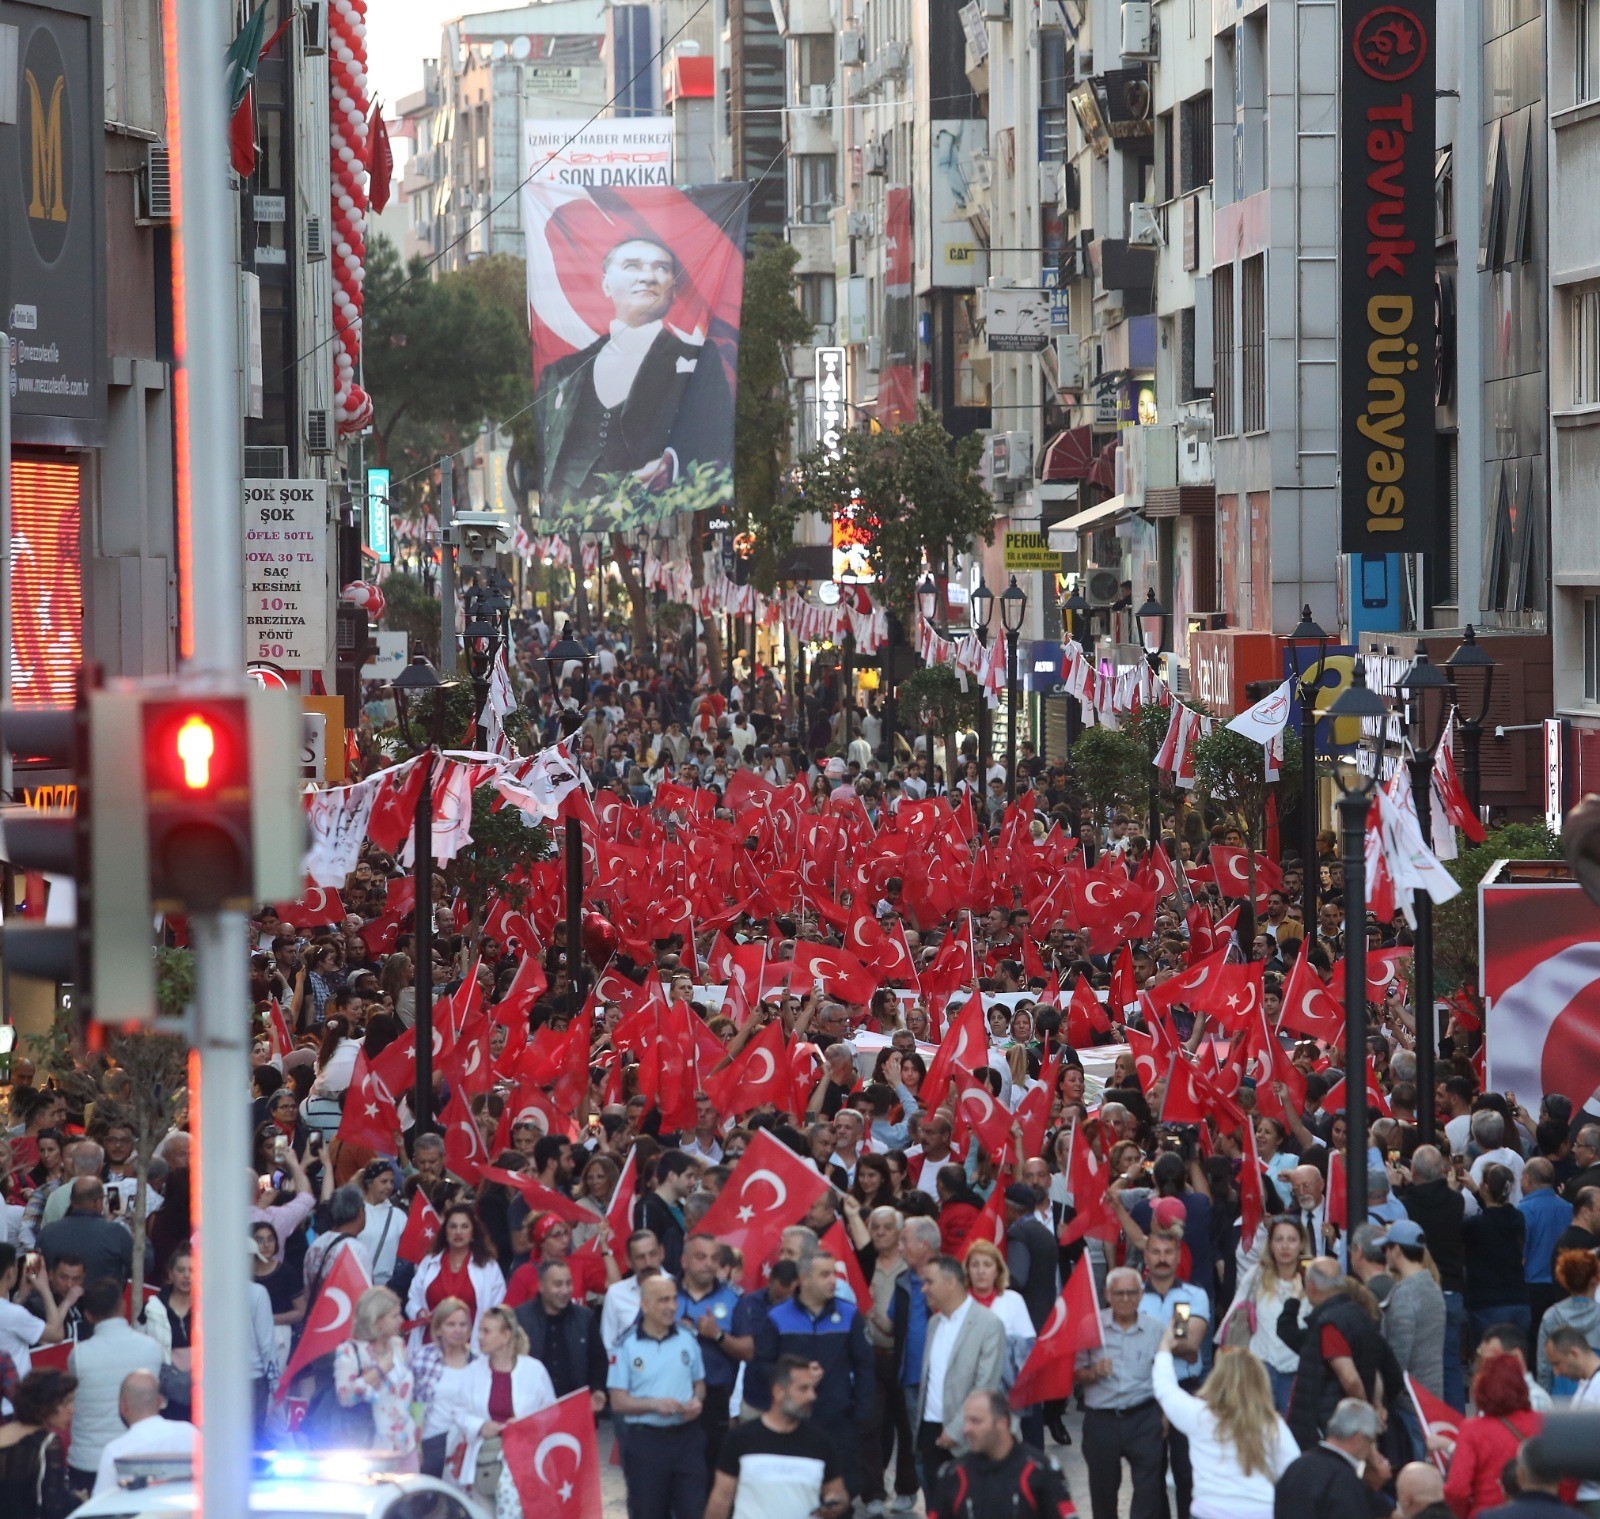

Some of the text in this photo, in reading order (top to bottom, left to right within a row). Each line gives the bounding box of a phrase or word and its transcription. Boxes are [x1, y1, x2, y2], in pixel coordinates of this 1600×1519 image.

[580, 134, 618, 145] HABER
[622, 131, 671, 145] MERKEZİ
[25, 69, 68, 222] M
[559, 165, 668, 187] SON DAKİKA
[949, 248, 969, 260] CAT
[1356, 93, 1418, 533] Tavuk Dünyası
[245, 489, 315, 505] ŞOK ŞOK
[260, 508, 295, 525] ŞOK
[246, 529, 280, 540] ÖFLE
[278, 553, 293, 562] 30
[297, 553, 314, 562] TL
[263, 568, 289, 579] SAÇ
[252, 581, 302, 592] KESİMİ
[247, 614, 306, 625] BREZİLYA
[259, 629, 293, 640] FÖNÜ
[258, 644, 301, 658] 50 TL
